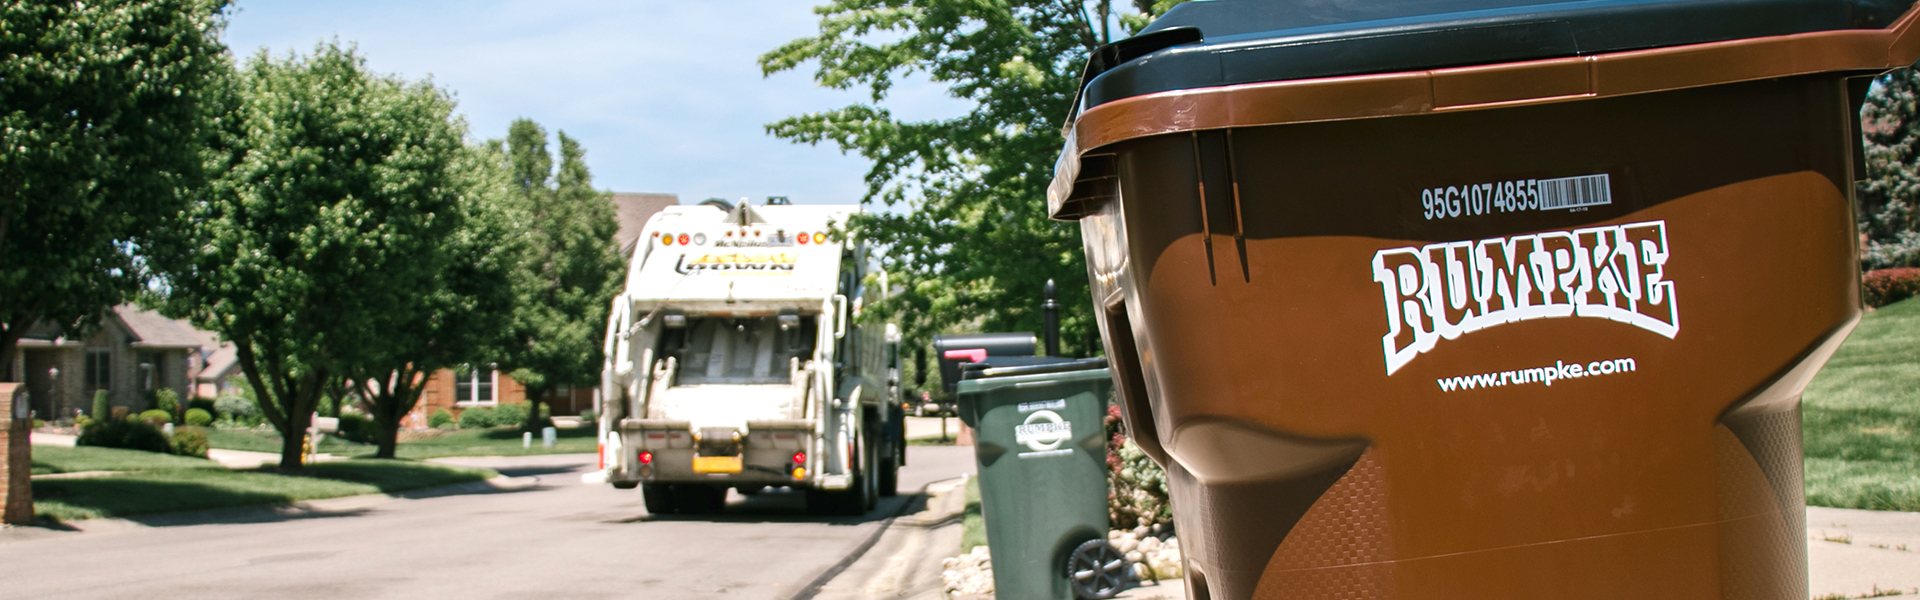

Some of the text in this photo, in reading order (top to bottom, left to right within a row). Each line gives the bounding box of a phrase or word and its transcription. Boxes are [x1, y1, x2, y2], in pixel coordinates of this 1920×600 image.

[1421, 179, 1539, 220] 95G1074855
[1372, 220, 1679, 376] RUMPKE
[1437, 357, 1636, 392] www.rumpke.com
[1018, 421, 1071, 434] RUMPKE
